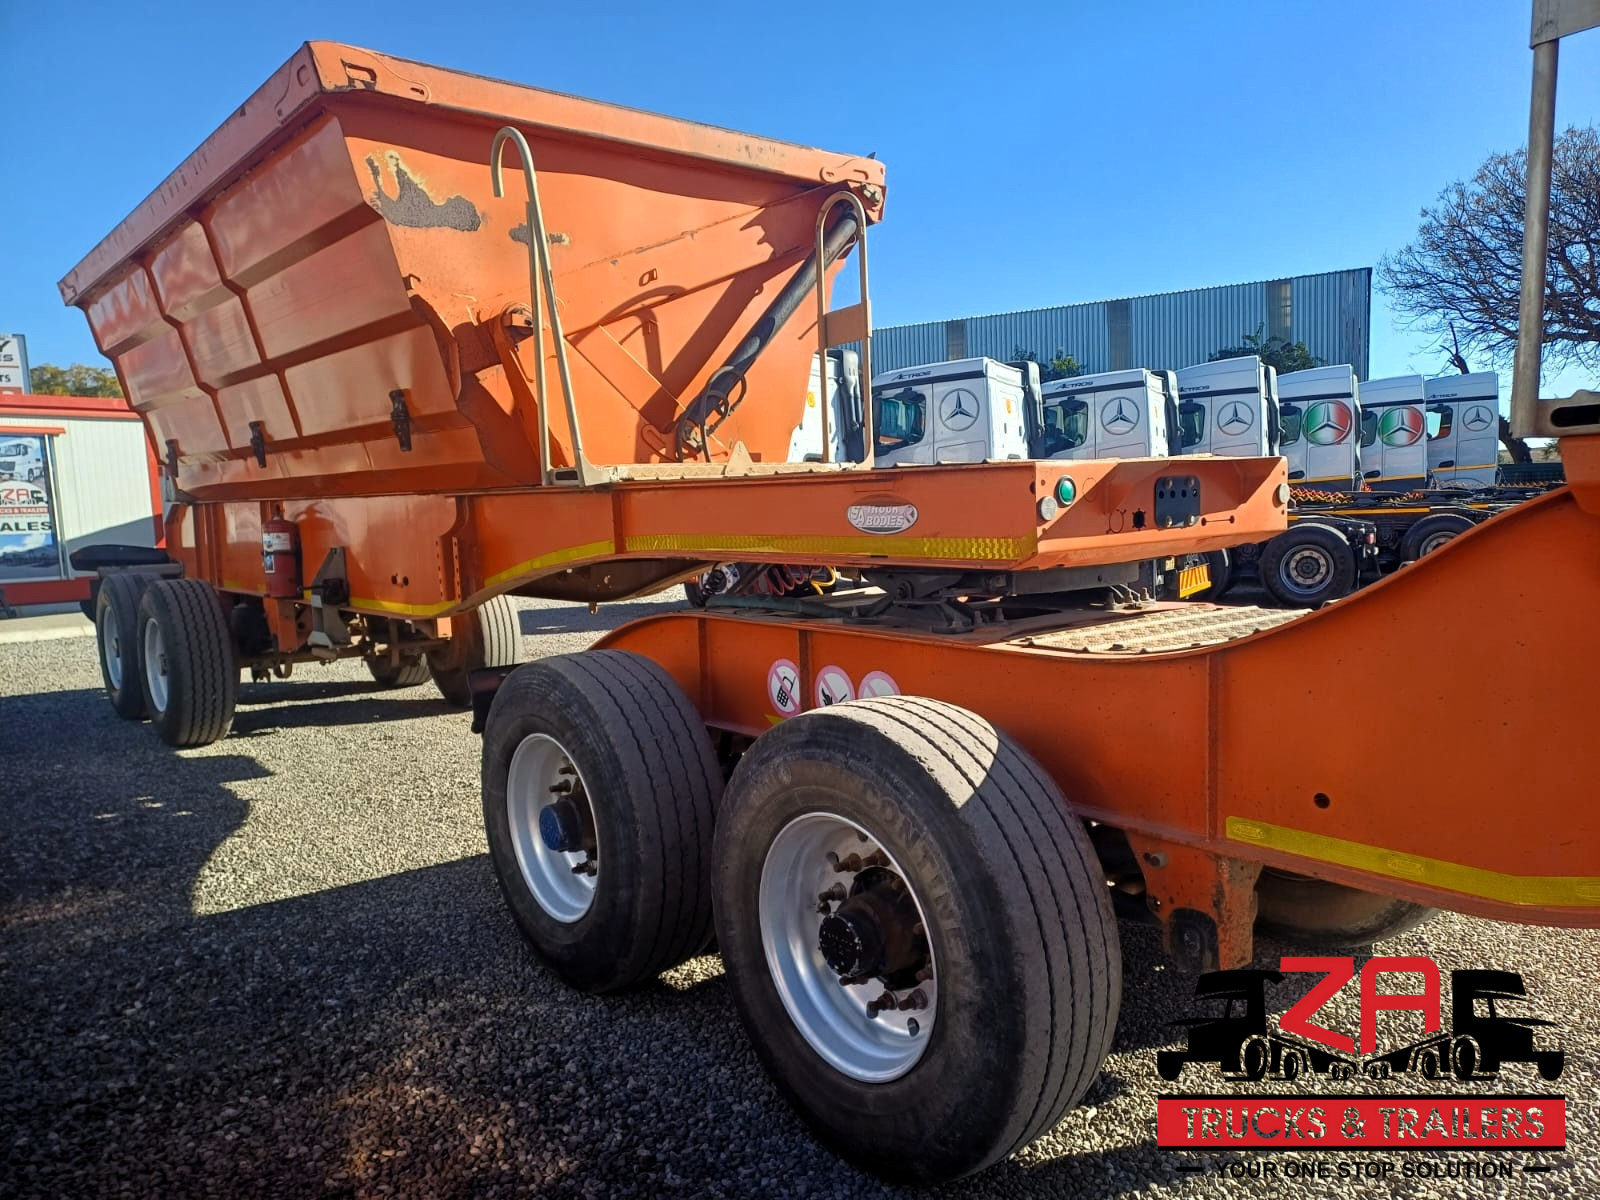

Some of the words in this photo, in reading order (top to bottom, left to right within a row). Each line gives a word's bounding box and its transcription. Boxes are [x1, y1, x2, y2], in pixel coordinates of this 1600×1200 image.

[891, 371, 931, 381] ACTROS
[1055, 381, 1094, 390] ACTROS
[866, 516, 904, 526] BODIES
[0, 521, 53, 532] ALES
